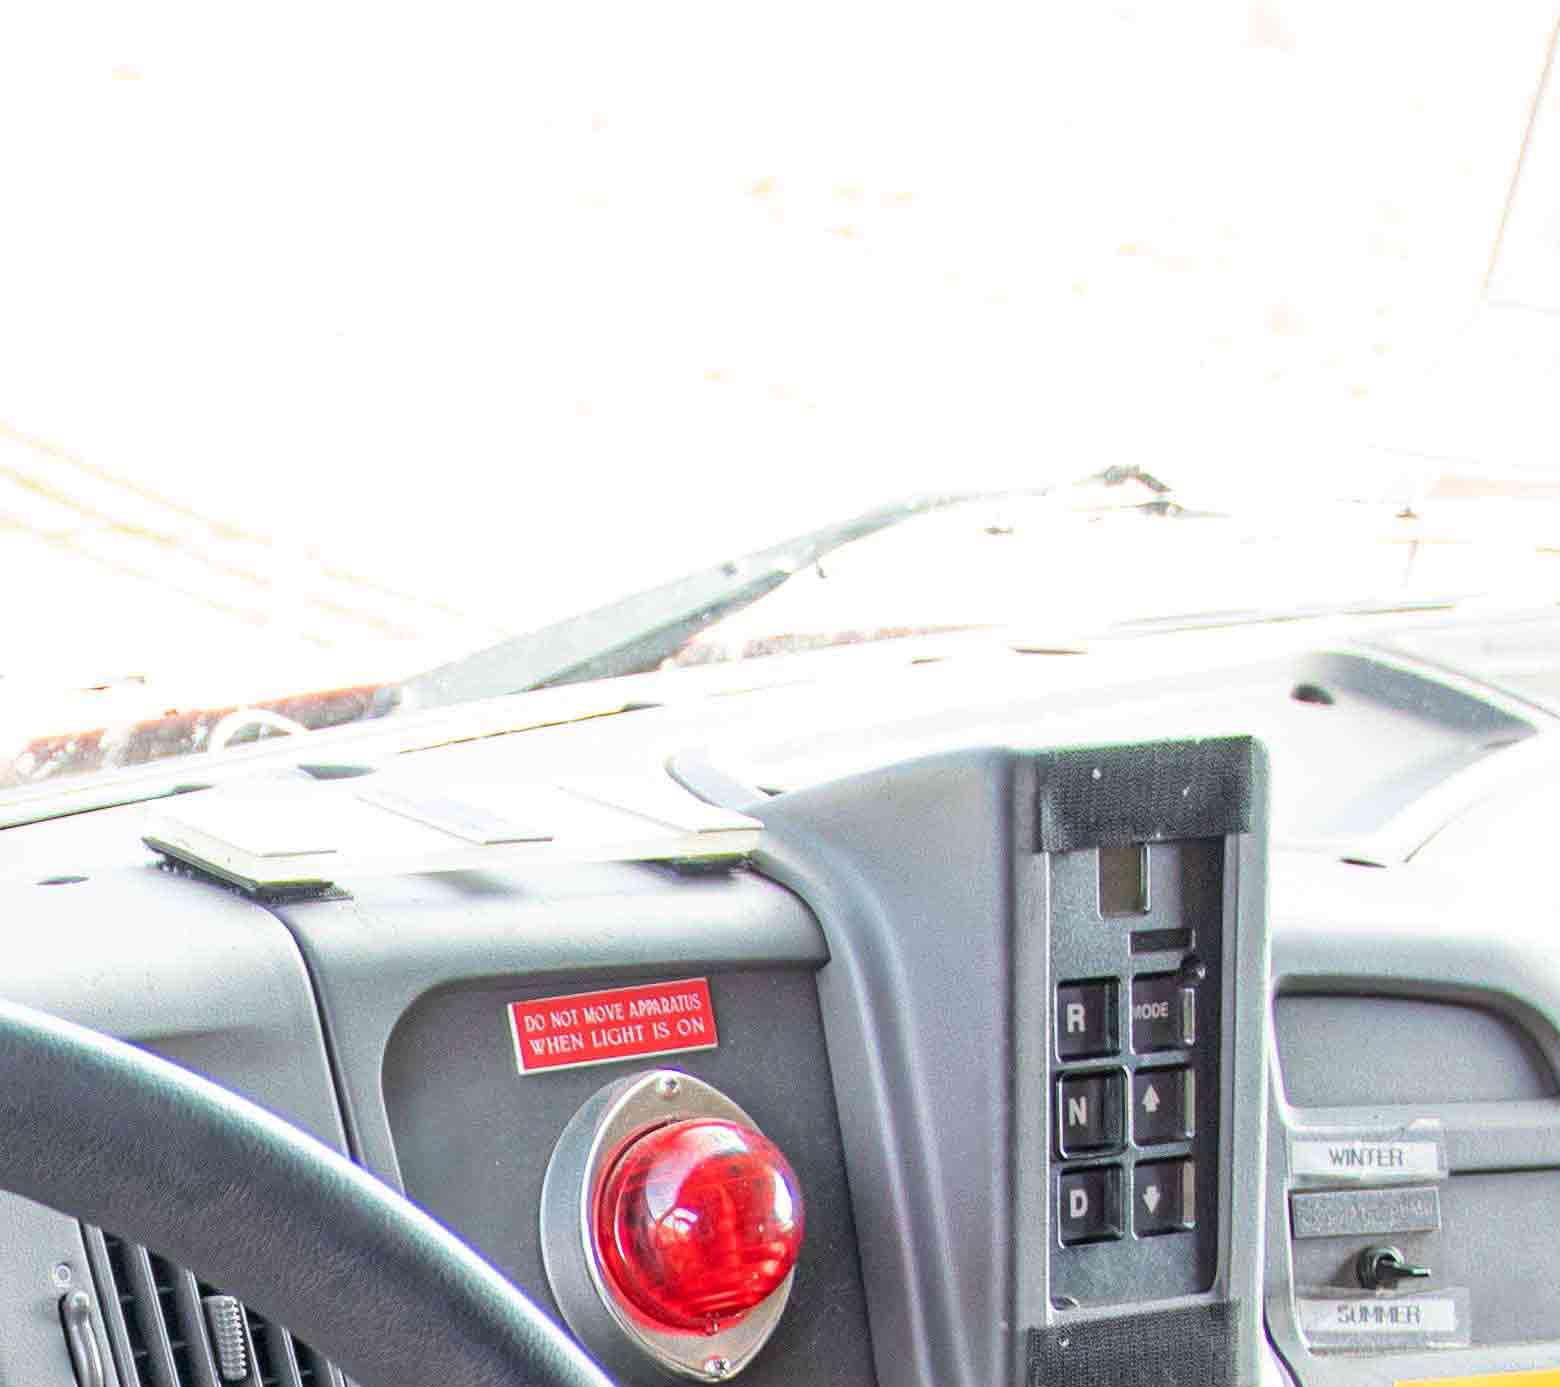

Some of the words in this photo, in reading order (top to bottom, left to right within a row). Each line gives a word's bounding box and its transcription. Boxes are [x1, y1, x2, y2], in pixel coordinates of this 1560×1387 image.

[523, 1015, 545, 1033] DO
[551, 1009, 578, 1028] NOT
[584, 1003, 624, 1024] MOVE
[630, 992, 701, 1018] APPARATUS
[1067, 1004, 1086, 1033] R
[1133, 1002, 1169, 1020] MODE
[530, 1033, 584, 1056] WHEN
[591, 1025, 644, 1048] LIGHT
[654, 1021, 670, 1040] IS
[677, 1017, 705, 1037] ON
[1069, 1096, 1088, 1126] N
[1329, 1148, 1404, 1168] WINTER
[1070, 1189, 1088, 1218] D
[1337, 1304, 1421, 1324] SUMMER
